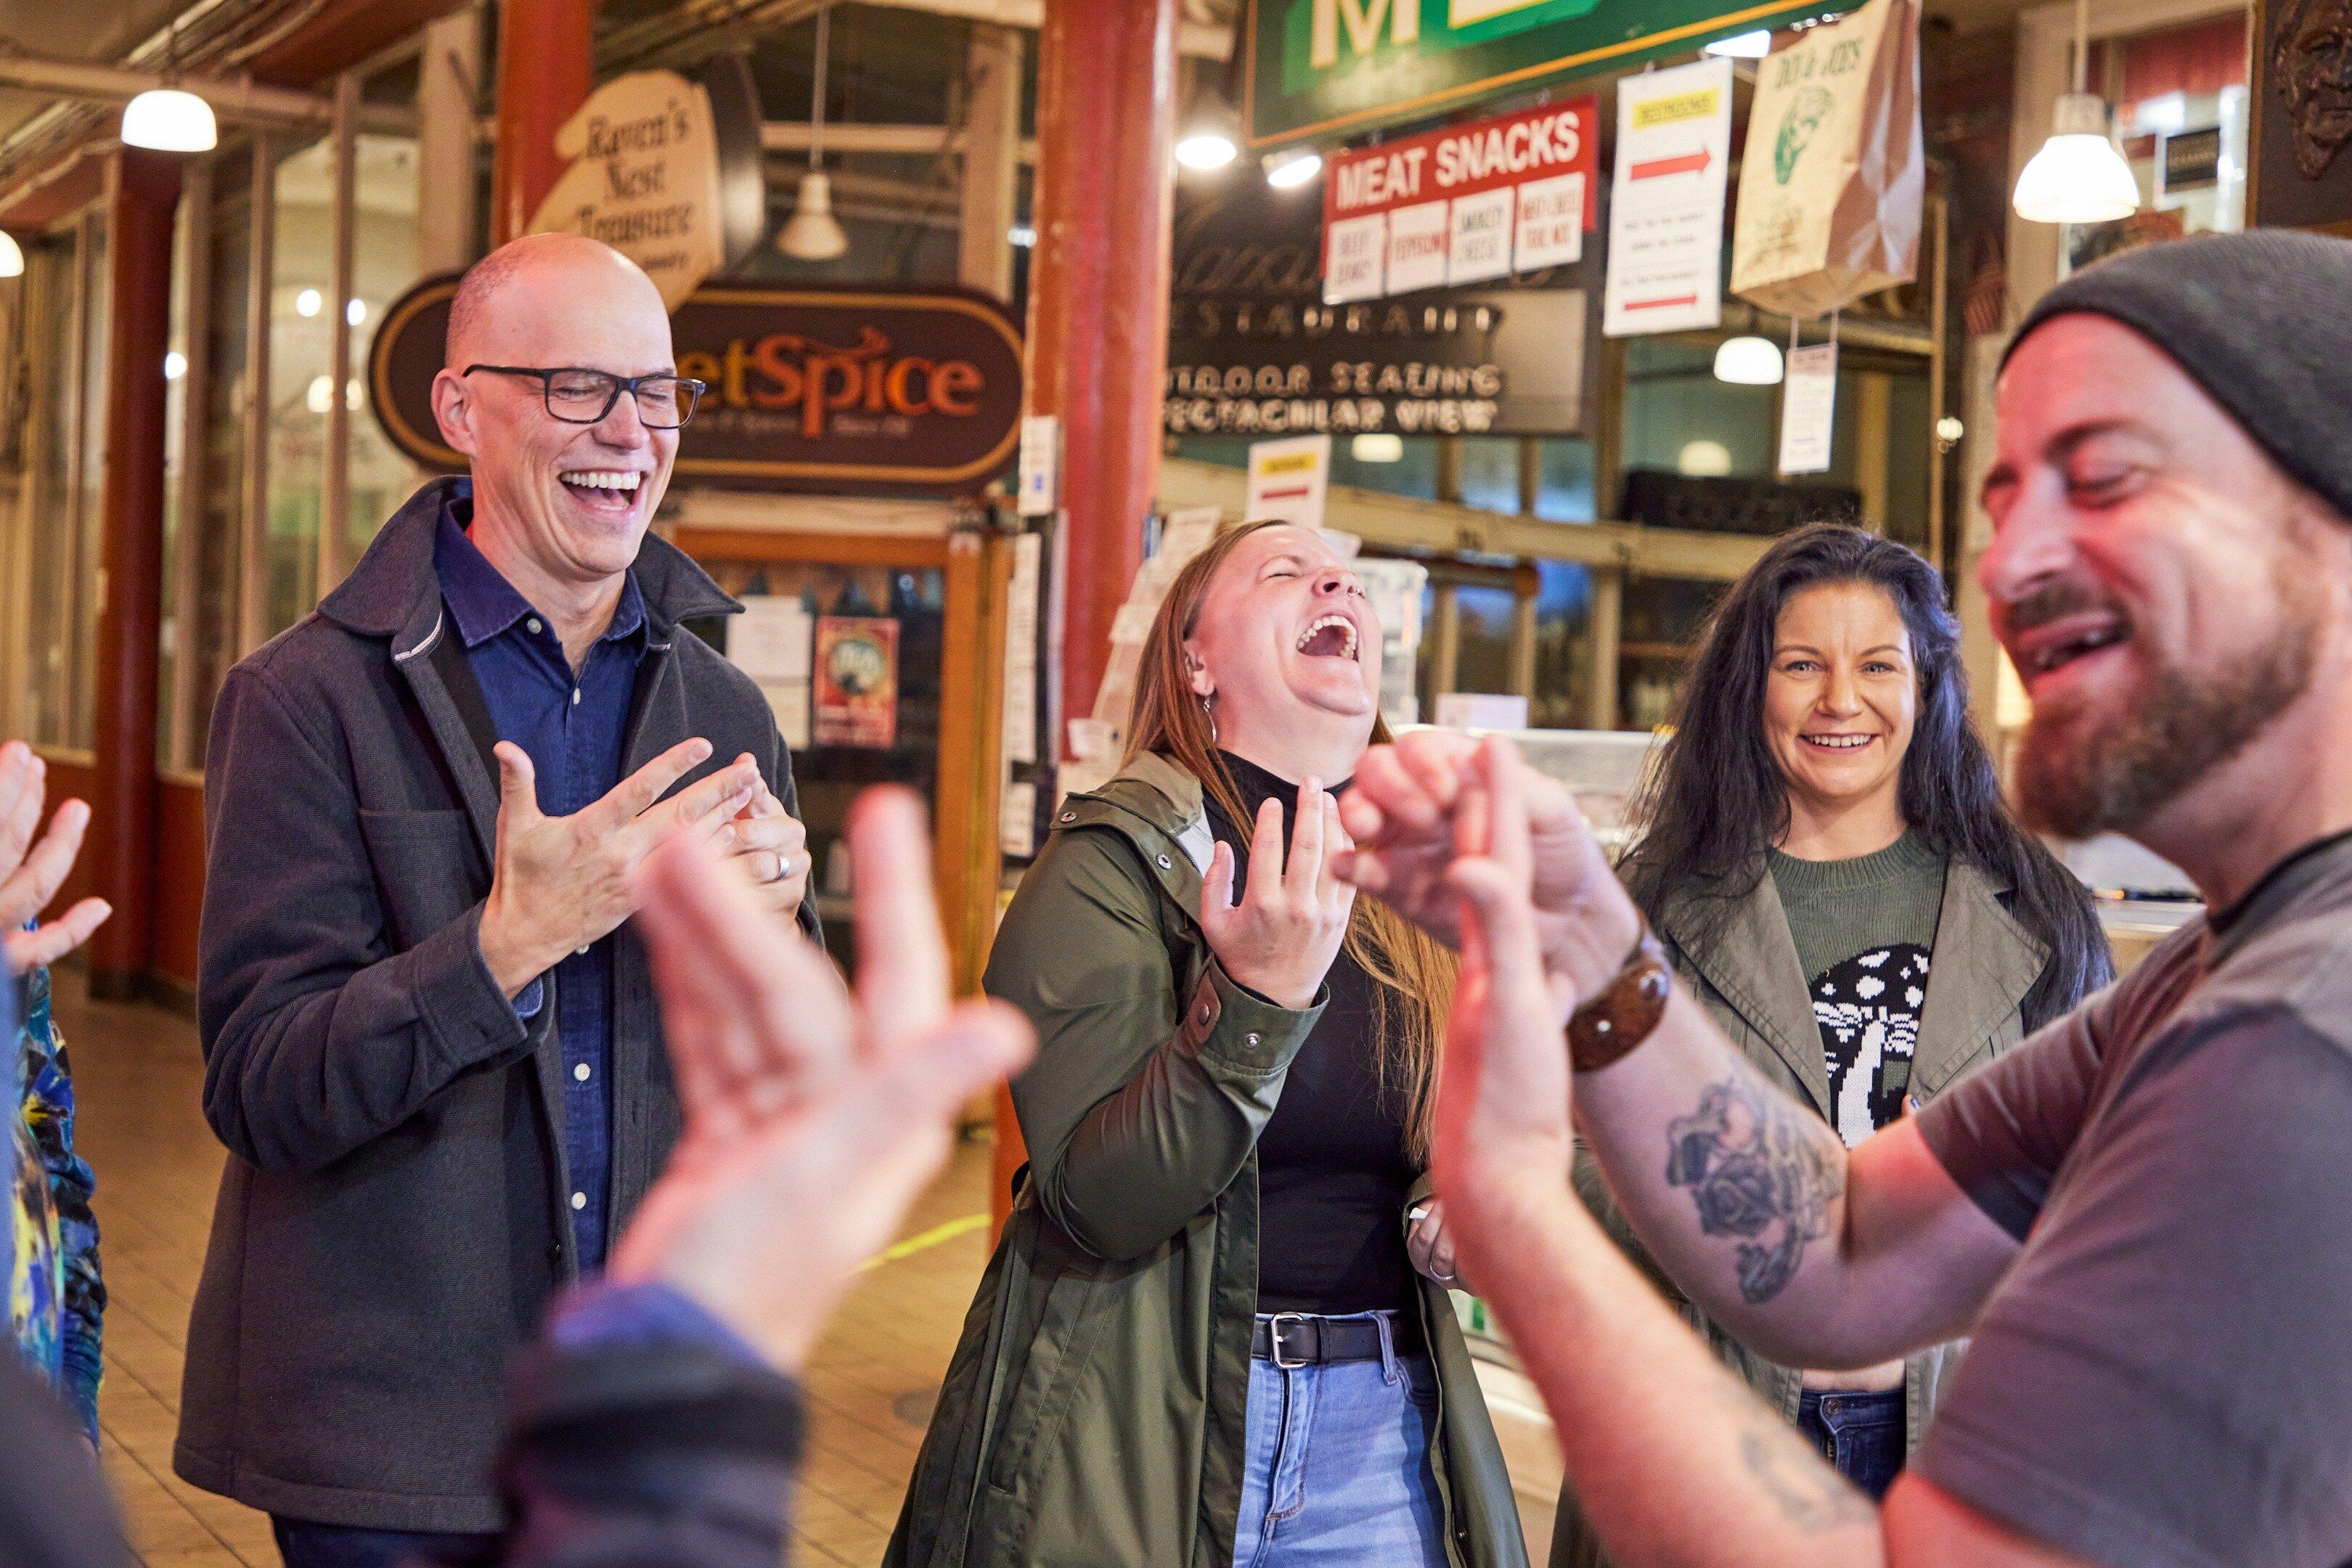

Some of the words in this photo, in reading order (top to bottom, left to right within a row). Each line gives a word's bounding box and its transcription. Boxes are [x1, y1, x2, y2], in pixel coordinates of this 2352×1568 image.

[1336, 147, 1427, 210] MEAT
[1434, 111, 1580, 187] SNACKS
[675, 328, 986, 437] etSpice
[1166, 362, 1311, 397] TDOOR
[1395, 399, 1499, 433] VIEW
